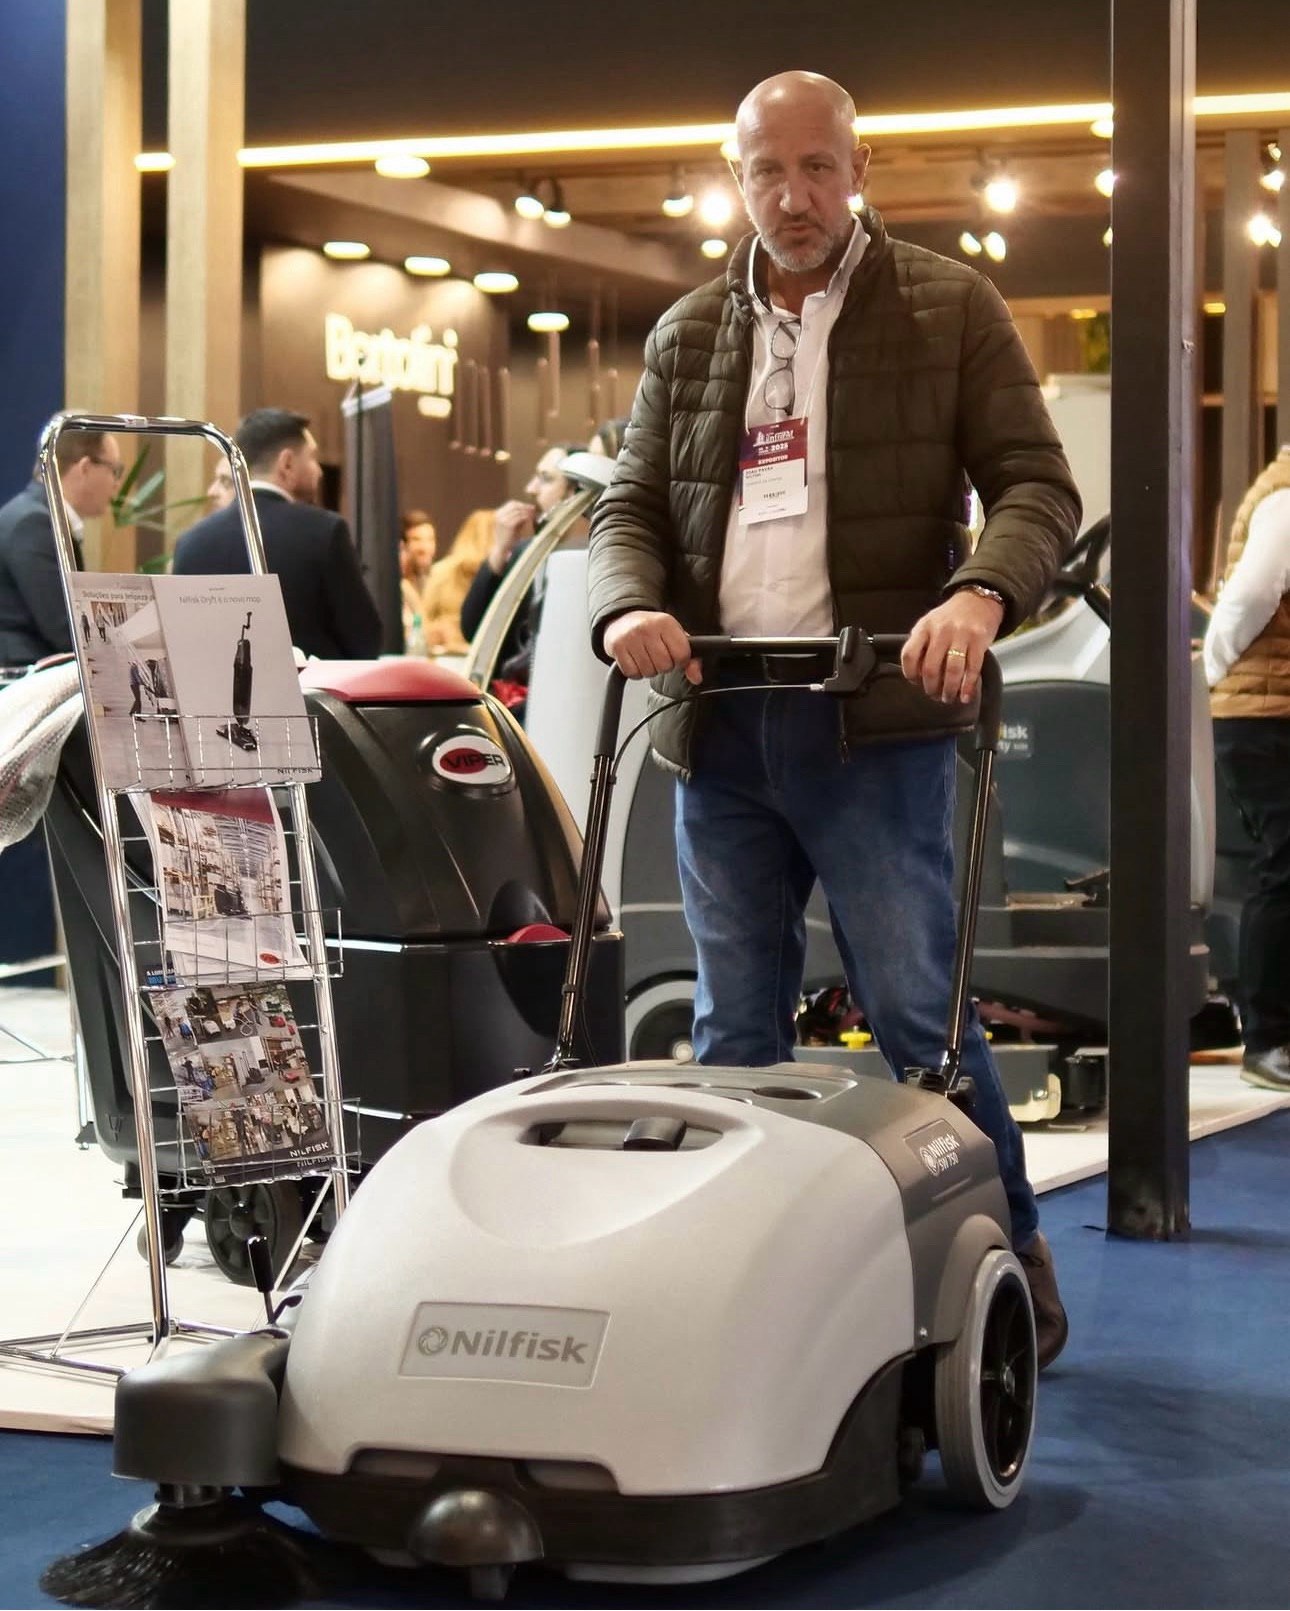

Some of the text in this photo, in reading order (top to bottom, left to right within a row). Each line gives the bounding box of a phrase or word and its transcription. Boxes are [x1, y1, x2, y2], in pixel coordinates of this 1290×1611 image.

[447, 753, 506, 768] VIPER
[289, 1141, 330, 1158] NILFISK
[927, 1133, 960, 1159] Nilfisk
[451, 1329, 588, 1365] Nilfisk
